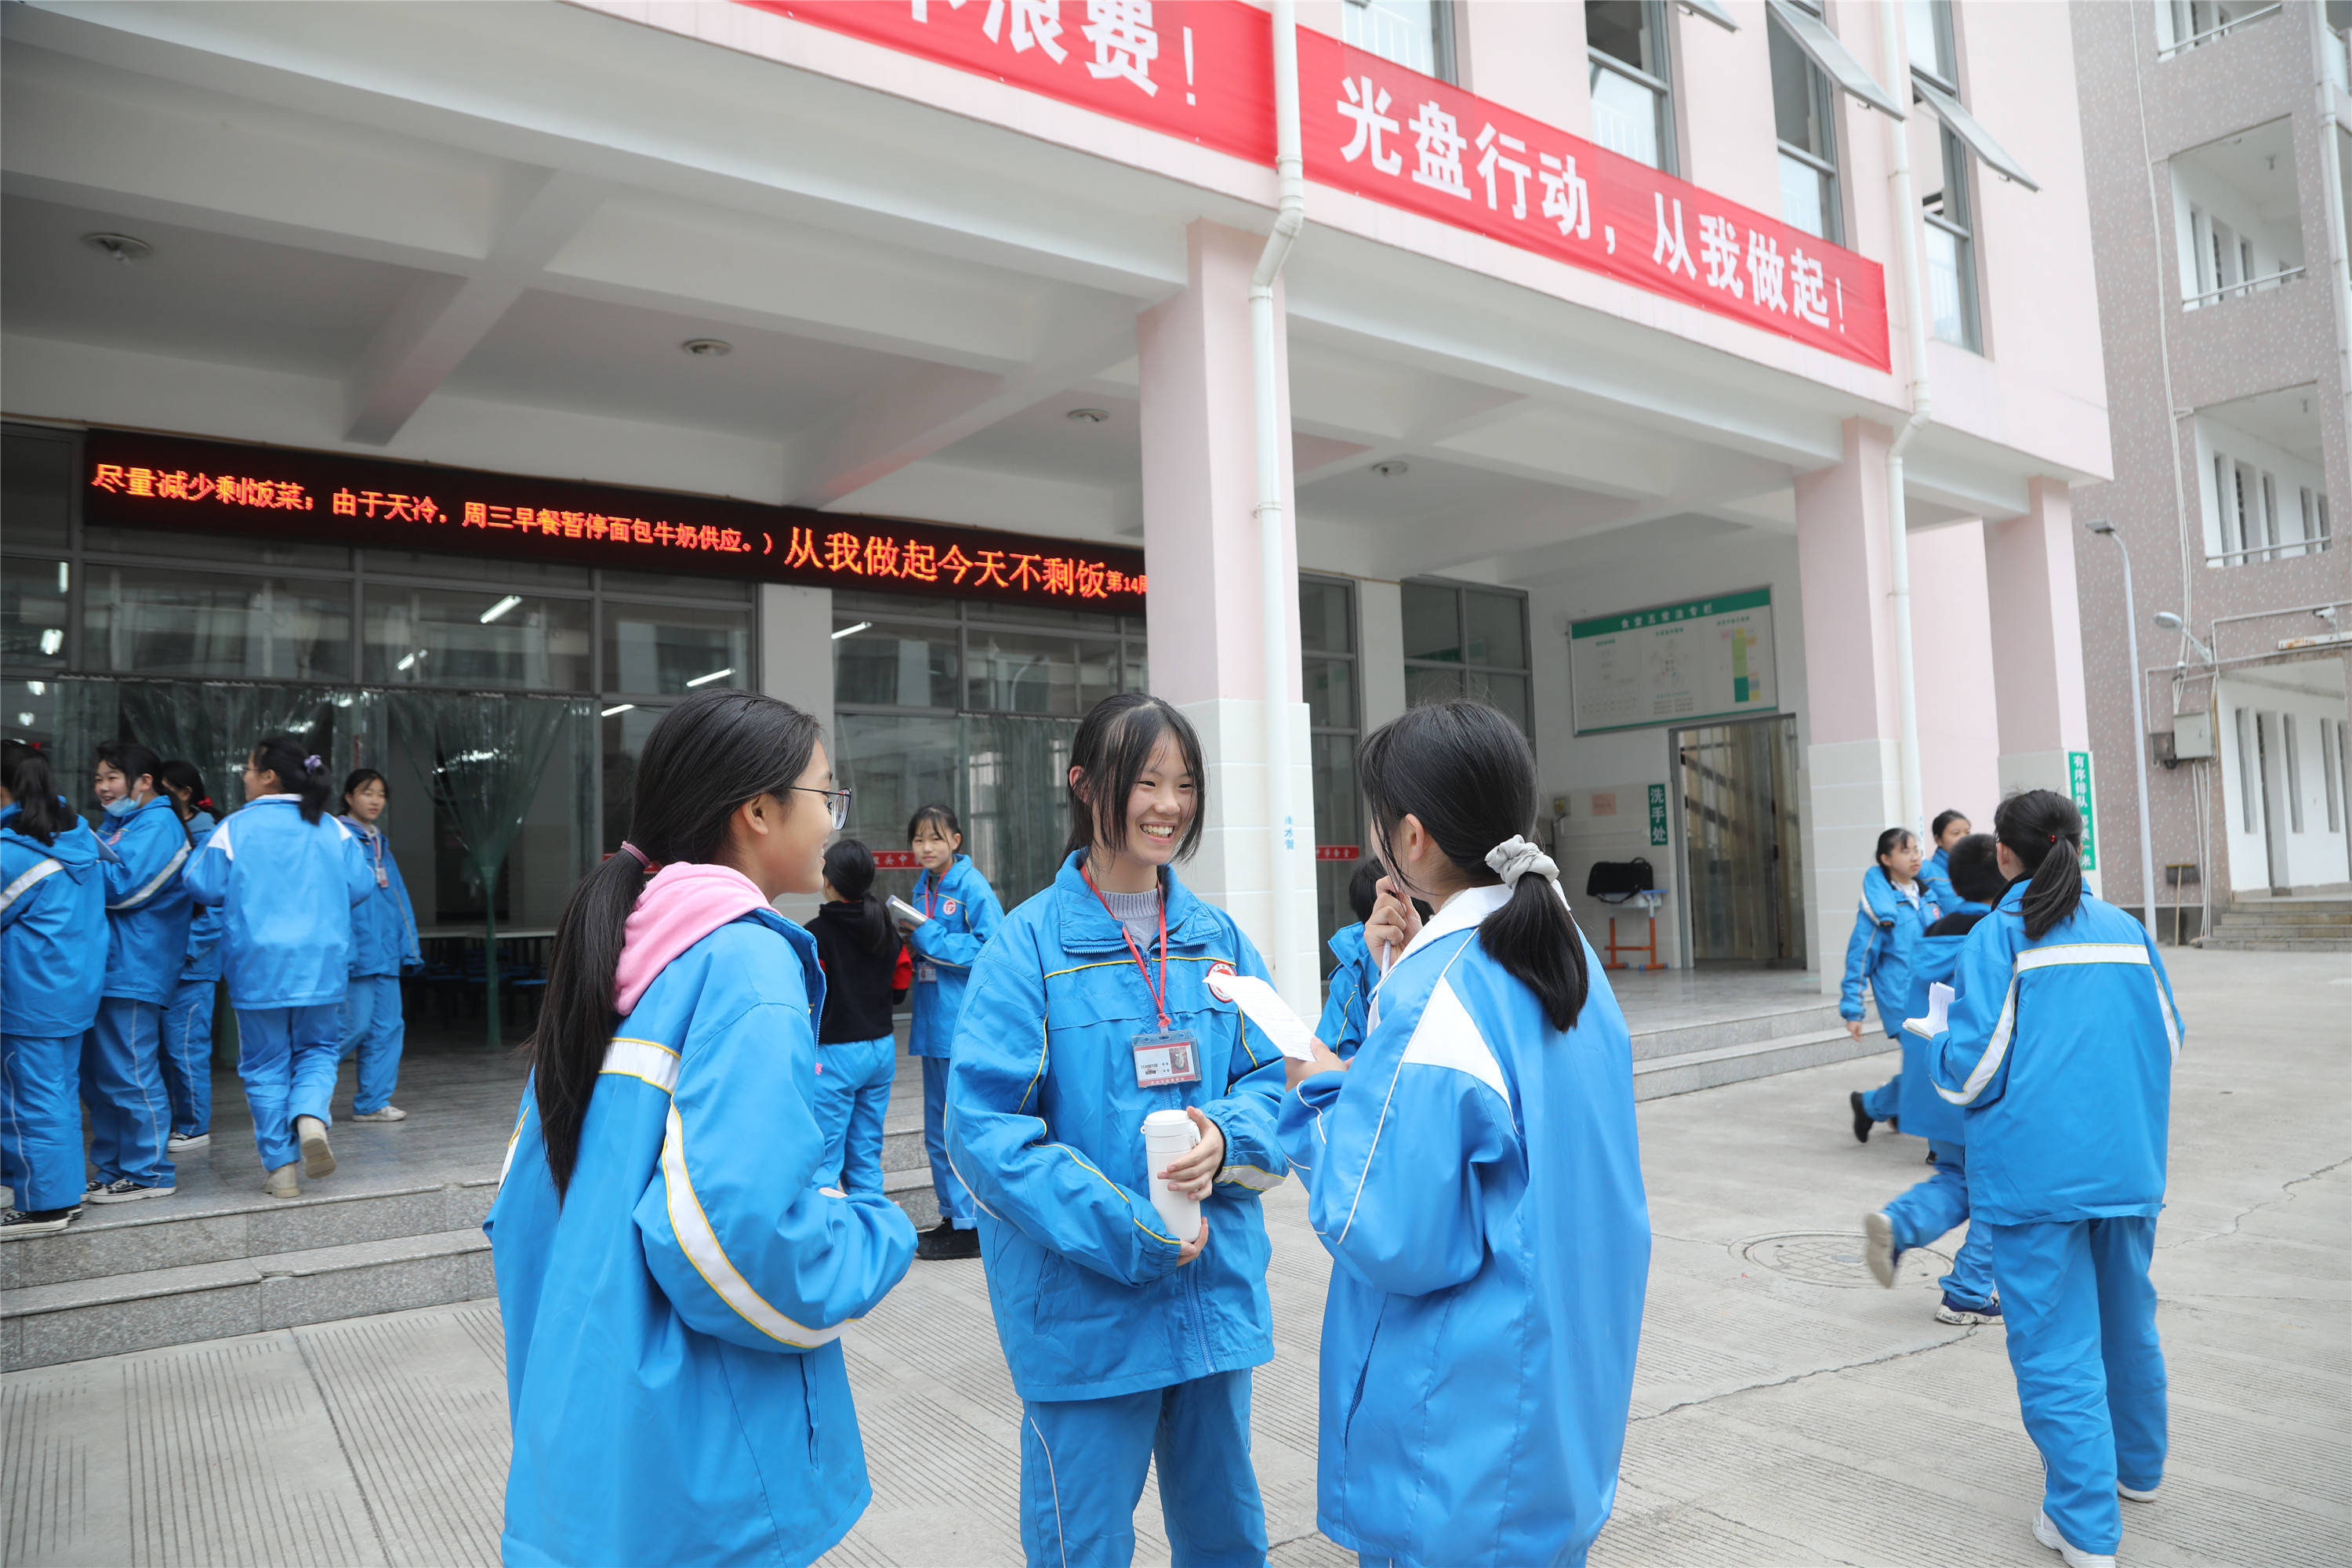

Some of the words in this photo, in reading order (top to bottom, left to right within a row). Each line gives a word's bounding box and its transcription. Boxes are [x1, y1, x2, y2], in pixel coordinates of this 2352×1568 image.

[912, 0, 1196, 106] 浪费！
[784, 526, 1109, 598] 从我做起今天不剩饭
[2073, 755, 2089, 808] 有序排队
[1650, 787, 1667, 843] 洗手处
